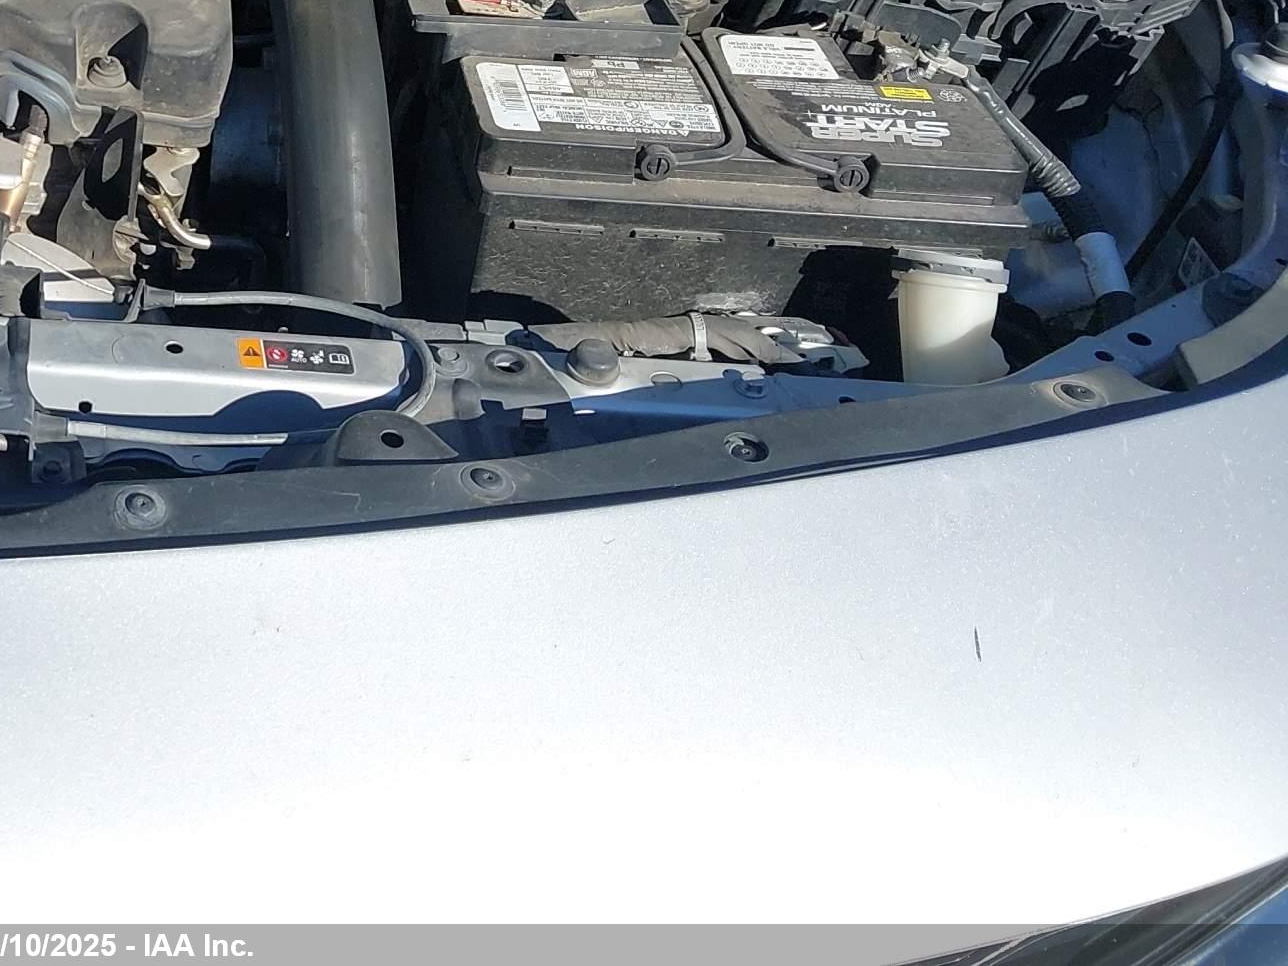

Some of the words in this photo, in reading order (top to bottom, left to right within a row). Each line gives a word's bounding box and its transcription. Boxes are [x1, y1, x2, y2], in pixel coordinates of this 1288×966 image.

[821, 104, 937, 118] PLATINUM
[575, 123, 678, 136] DANGER/POISON
[803, 114, 950, 137] START
[811, 126, 944, 147] SUPER
